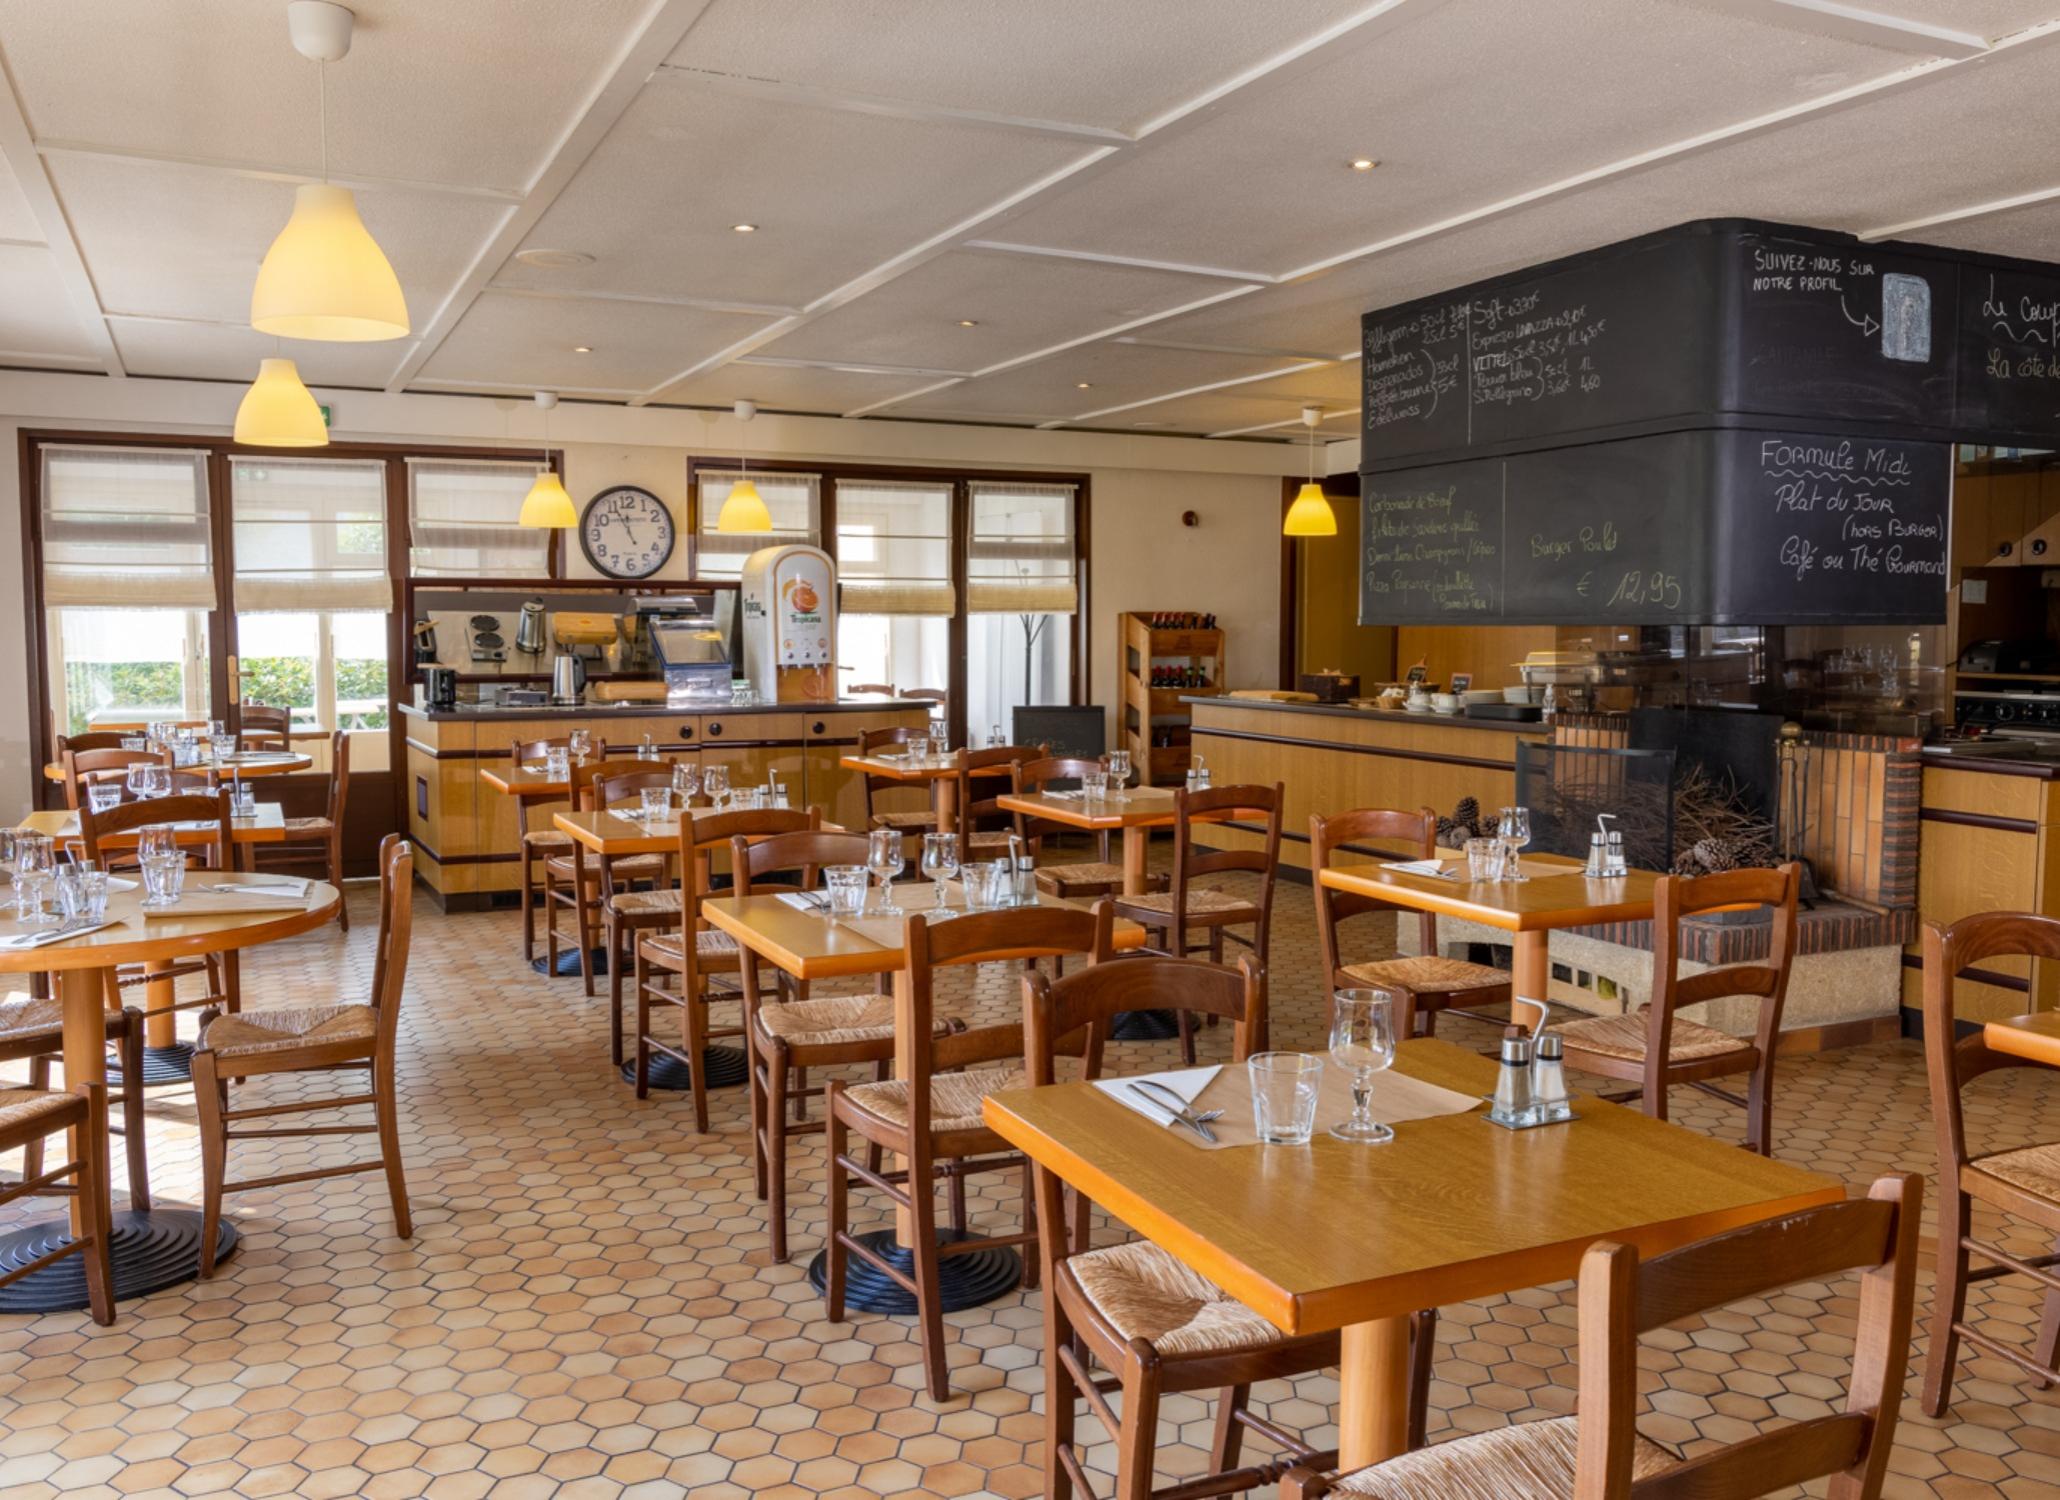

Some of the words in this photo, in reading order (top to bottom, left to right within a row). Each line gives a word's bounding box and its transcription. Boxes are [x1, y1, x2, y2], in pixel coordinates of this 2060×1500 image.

[1849, 260, 1875, 276] SUR
[1753, 276, 1793, 292] NOTRE
[1800, 277, 1843, 292] PROFIL
[1986, 347, 2010, 380] La
[2017, 352, 2045, 379] côte
[619, 495, 635, 509] 12
[1774, 480, 1823, 513] Plat
[1827, 487, 1849, 511] du
[594, 513, 609, 527] 10
[650, 509, 661, 523] 2
[657, 525, 667, 539] 3
[597, 544, 607, 557] 8
[651, 542, 660, 555] 4
[611, 554, 620, 568] 7
[626, 558, 636, 571] 6
[1780, 535, 1818, 581] Café
[1822, 554, 1844, 570] ou
[1850, 544, 1884, 572] Thé
[1576, 570, 1593, 598] €
[1606, 571, 1682, 610] 12,95
